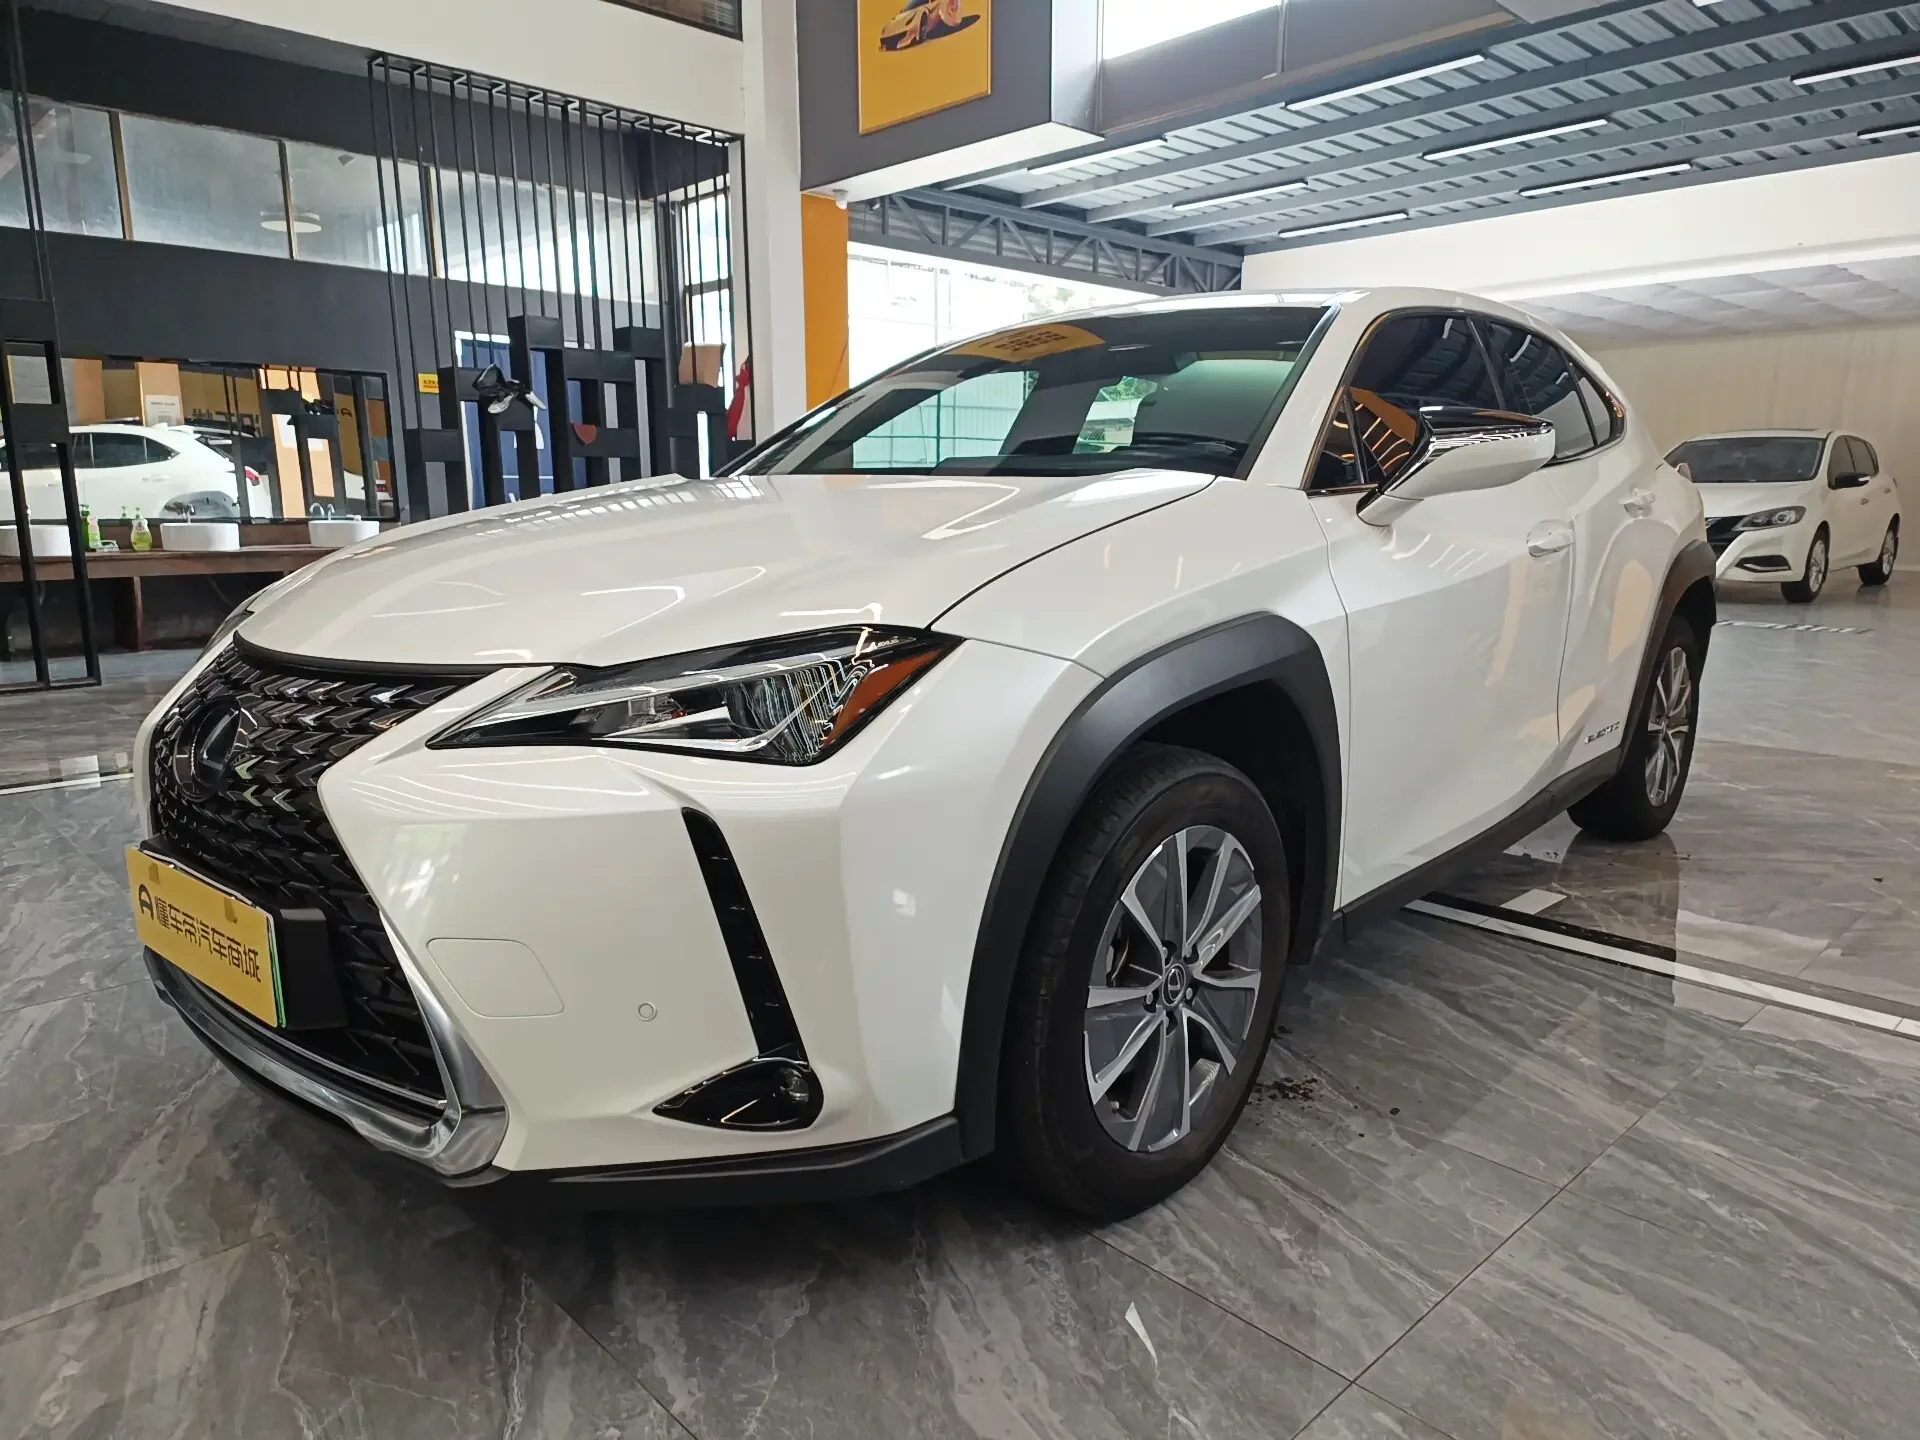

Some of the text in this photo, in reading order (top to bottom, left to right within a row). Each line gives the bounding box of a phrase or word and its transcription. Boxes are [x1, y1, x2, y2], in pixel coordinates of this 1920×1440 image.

[153, 895, 262, 983] 懂车帝汽车商城
